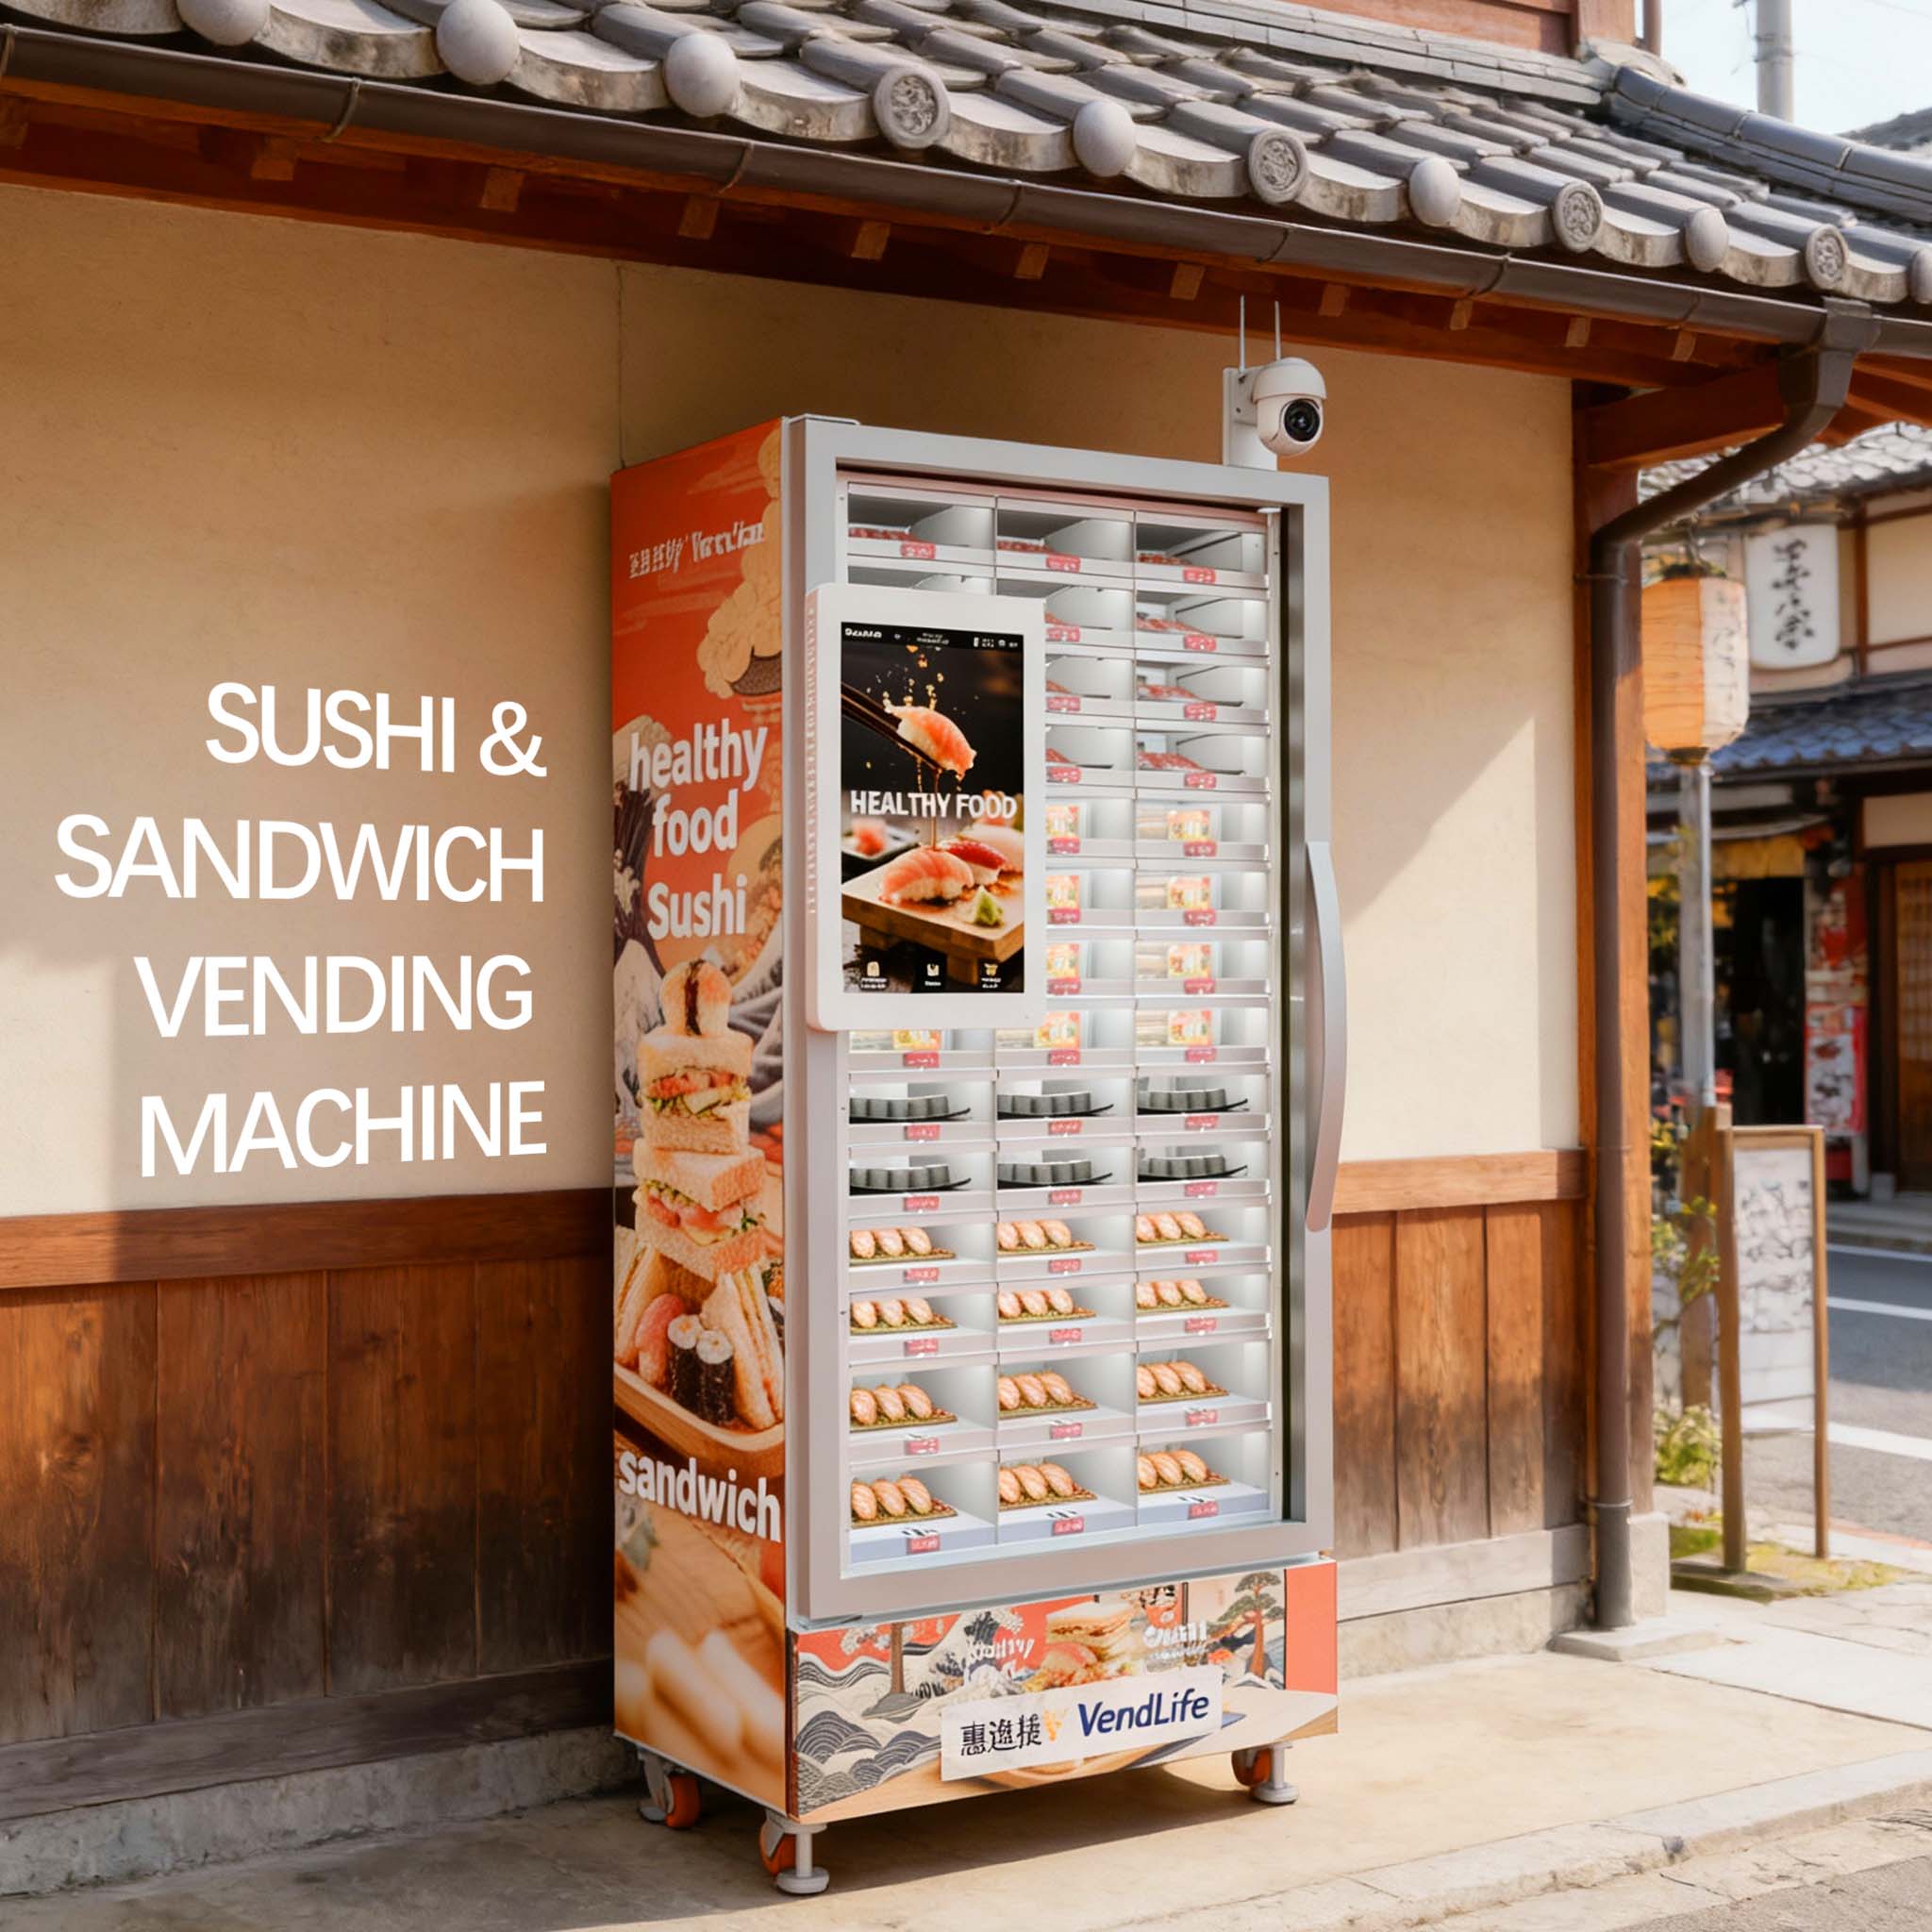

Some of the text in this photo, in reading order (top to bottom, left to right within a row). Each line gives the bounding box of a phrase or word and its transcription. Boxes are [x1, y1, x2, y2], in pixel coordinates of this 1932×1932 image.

[628, 718, 769, 792] healthy
[652, 788, 739, 858] food
[851, 790, 1019, 820] HEALTHY FOOD
[647, 873, 747, 941] Sushi
[618, 1450, 782, 1543] sandwich
[1077, 1688, 1210, 1737] VendLife
